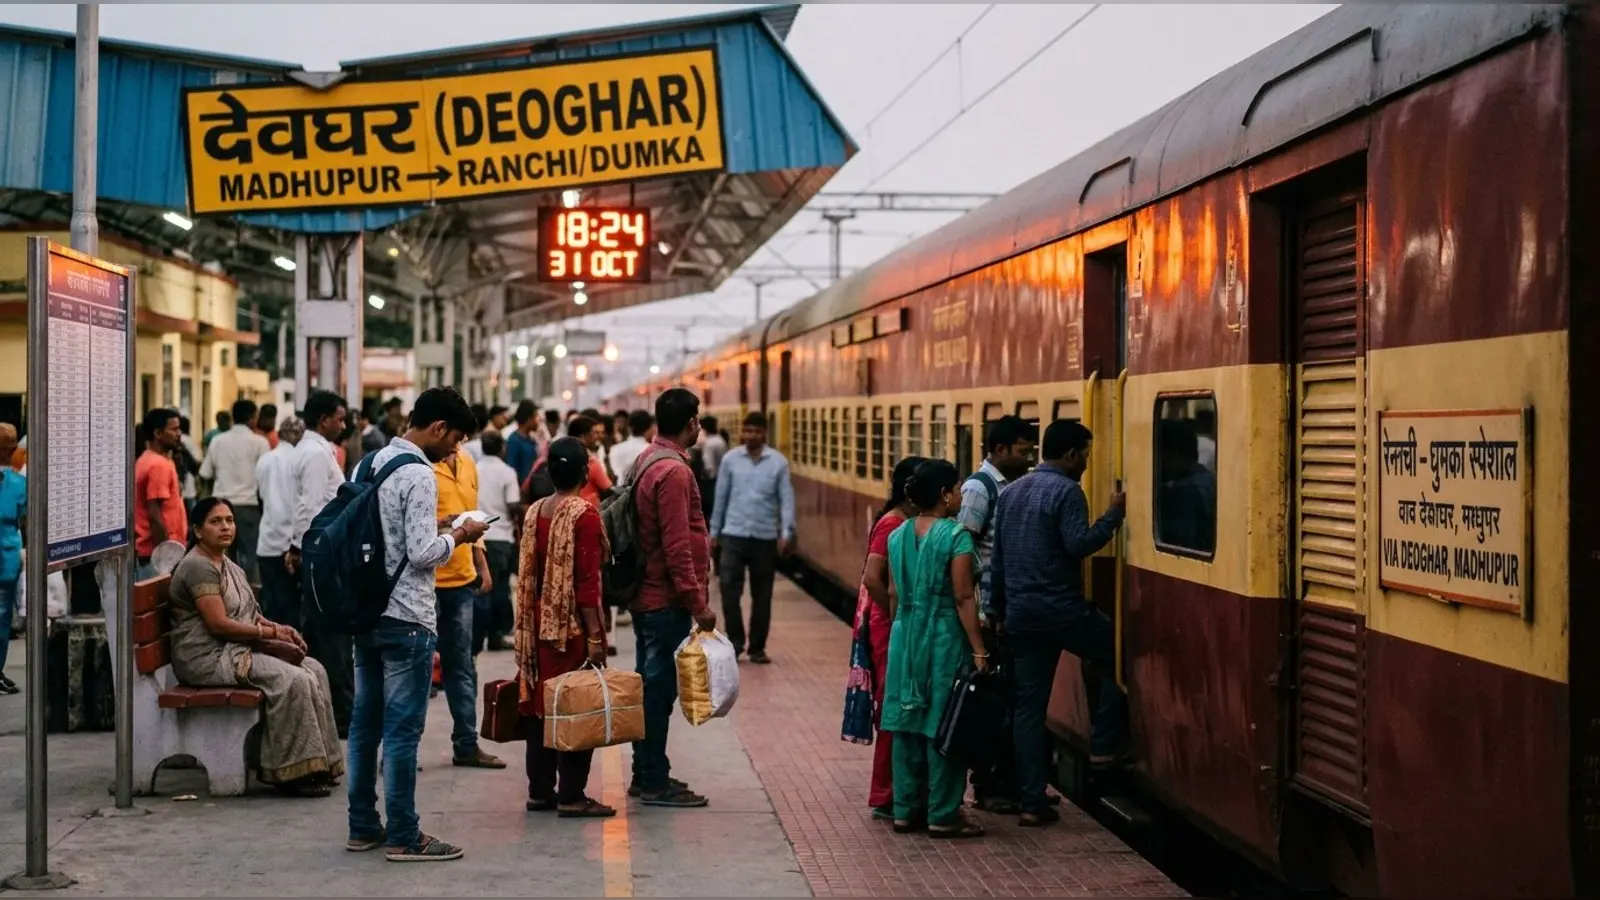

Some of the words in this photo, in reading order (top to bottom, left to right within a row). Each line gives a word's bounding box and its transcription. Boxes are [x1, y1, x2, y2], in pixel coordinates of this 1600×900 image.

[199, 92, 420, 164] देवघर
[435, 65, 707, 156] (DEOGHAR)
[219, 165, 402, 203] MADHUPUR
[457, 135, 705, 187] RANCHI/DUMKA
[557, 211, 644, 248] 18:24
[590, 250, 639, 277] OCT
[1383, 537, 1399, 568] VIA
[1401, 540, 1451, 582] DEOGHAR,
[1454, 548, 1519, 587] MADHUPUR
